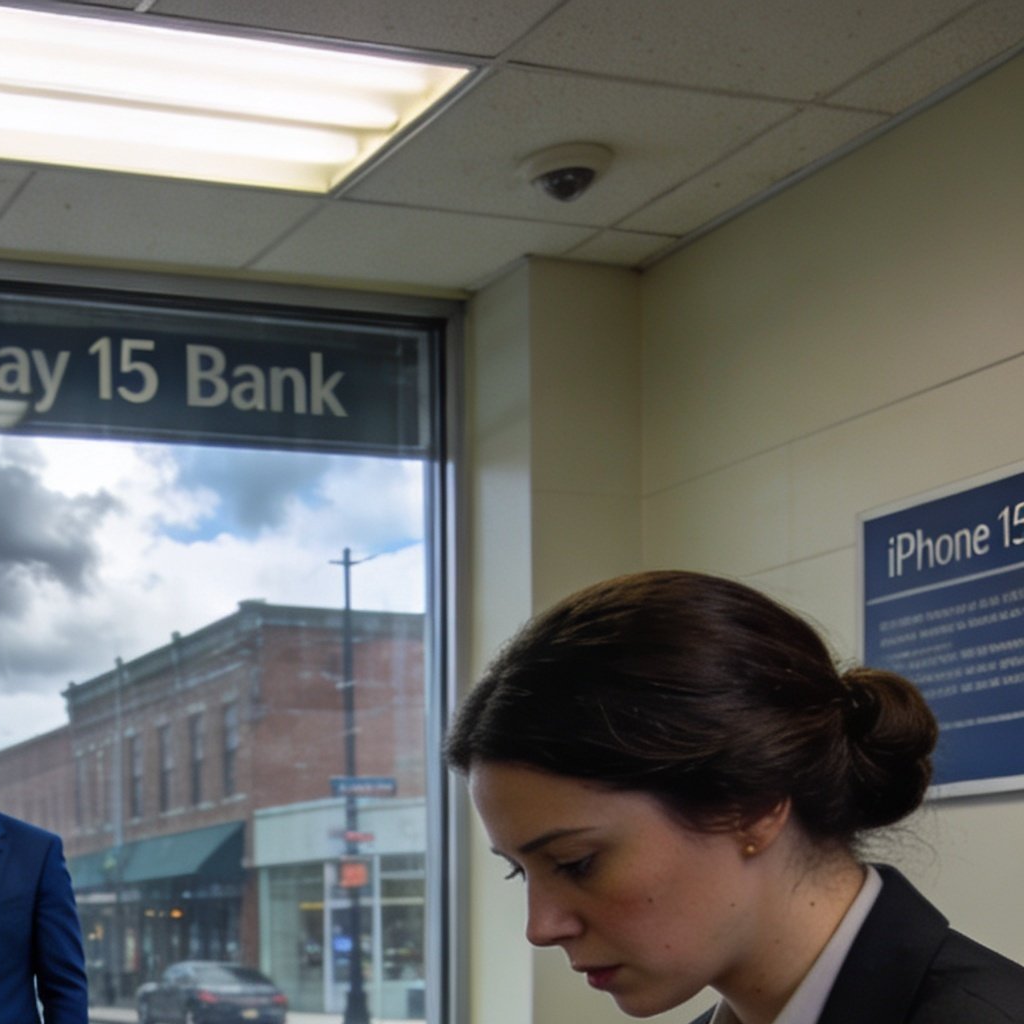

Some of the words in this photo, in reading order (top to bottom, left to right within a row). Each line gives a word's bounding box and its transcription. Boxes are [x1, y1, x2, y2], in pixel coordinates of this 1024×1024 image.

[88, 337, 158, 403] 15
[186, 345, 347, 417] Bank
[888, 524, 990, 578] iPhone
